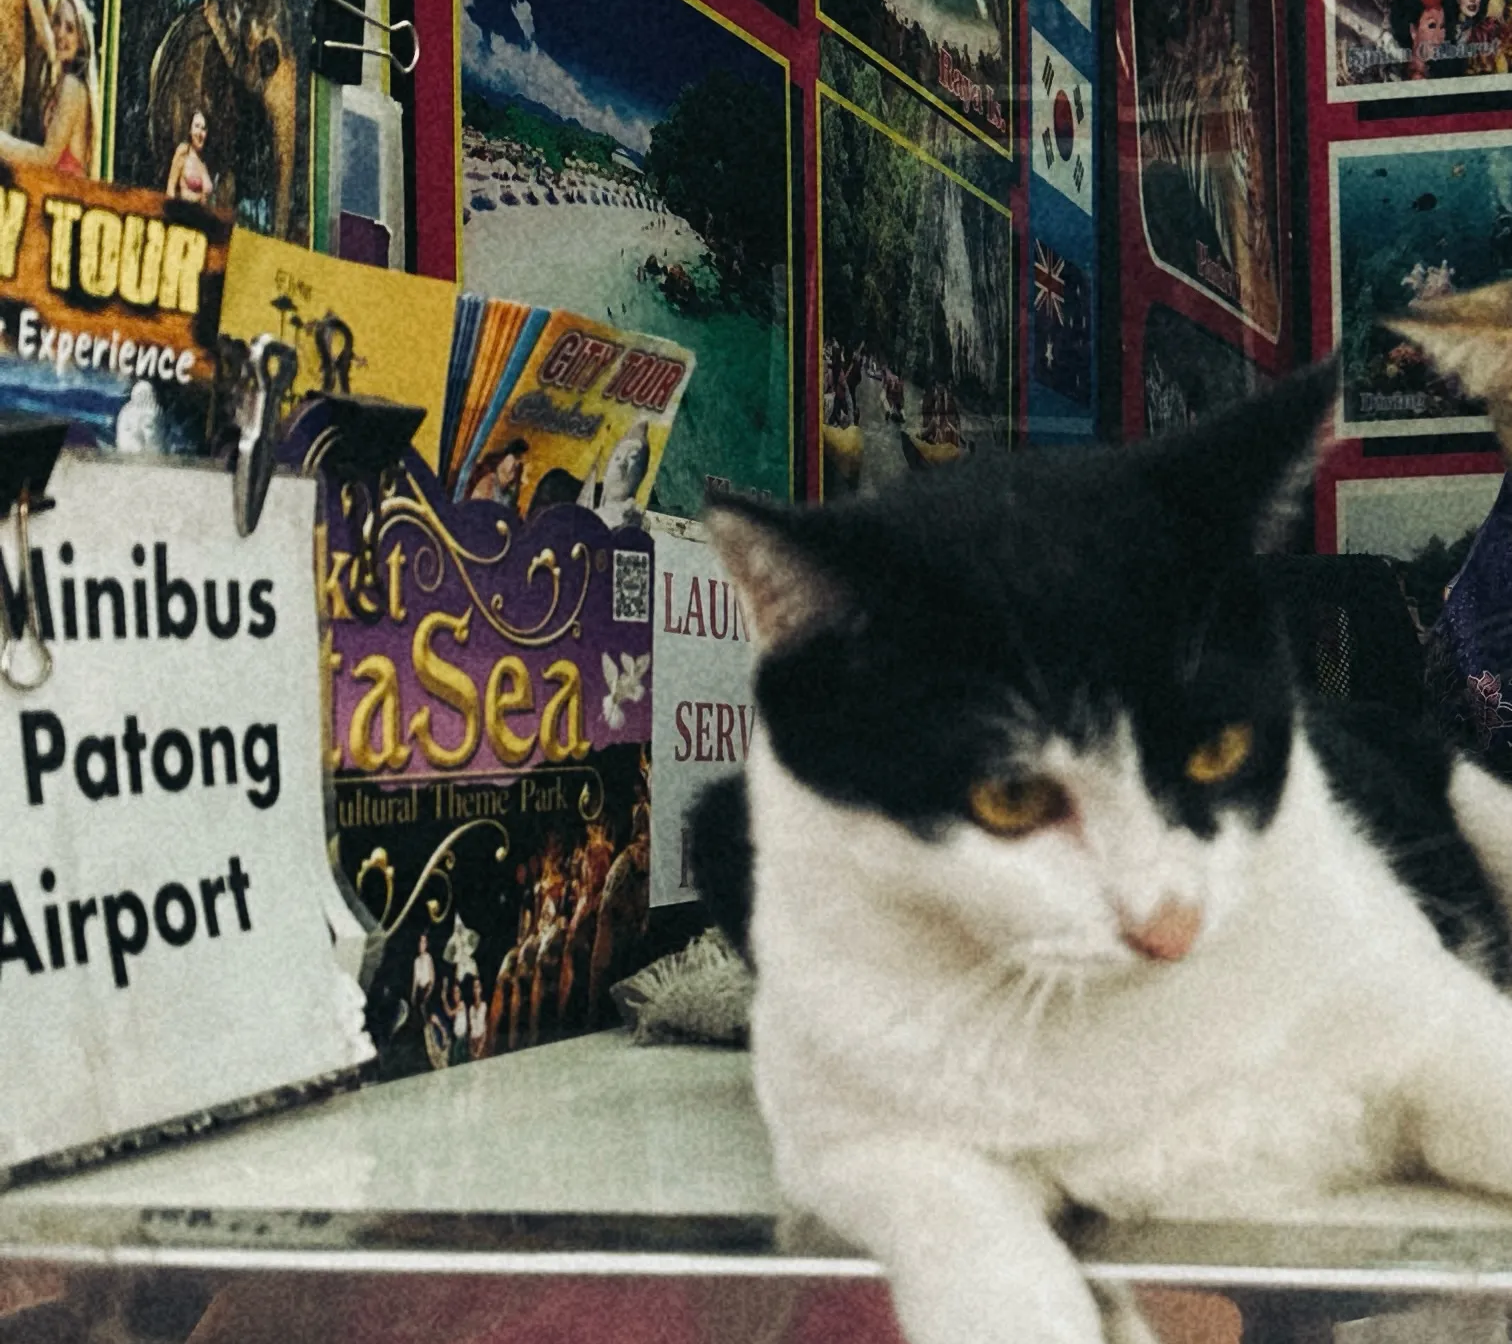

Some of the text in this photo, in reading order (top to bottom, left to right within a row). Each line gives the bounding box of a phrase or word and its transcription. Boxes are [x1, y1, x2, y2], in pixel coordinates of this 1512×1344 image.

[45, 196, 208, 314] TOUR
[18, 307, 197, 386] Experience
[540, 329, 686, 414] CITY TOUR
[20, 708, 281, 810] Patong
[431, 782, 510, 822] Theme
[520, 776, 569, 812] Park
[0, 856, 253, 988] Airport
